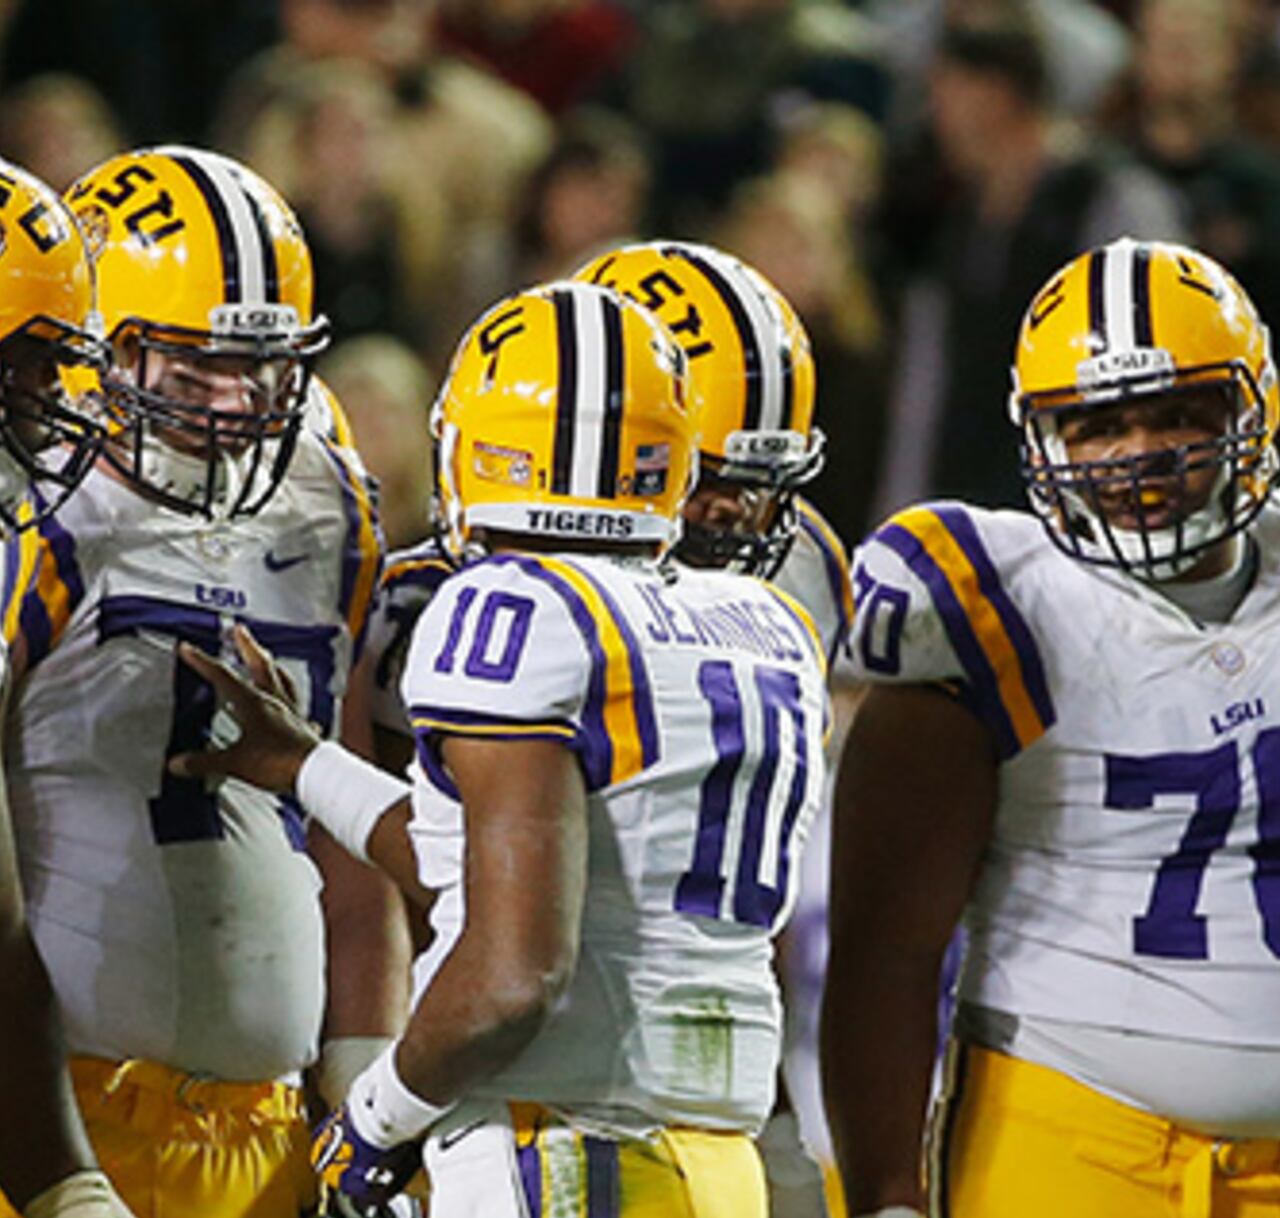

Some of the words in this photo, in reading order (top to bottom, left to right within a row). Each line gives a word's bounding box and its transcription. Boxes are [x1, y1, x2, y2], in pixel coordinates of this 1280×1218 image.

[233, 310, 278, 328] LSU
[526, 509, 635, 536] TIGERS
[195, 582, 247, 609] LSU
[434, 586, 535, 684] 10
[1210, 697, 1265, 736] LSU
[673, 660, 809, 930] 10
